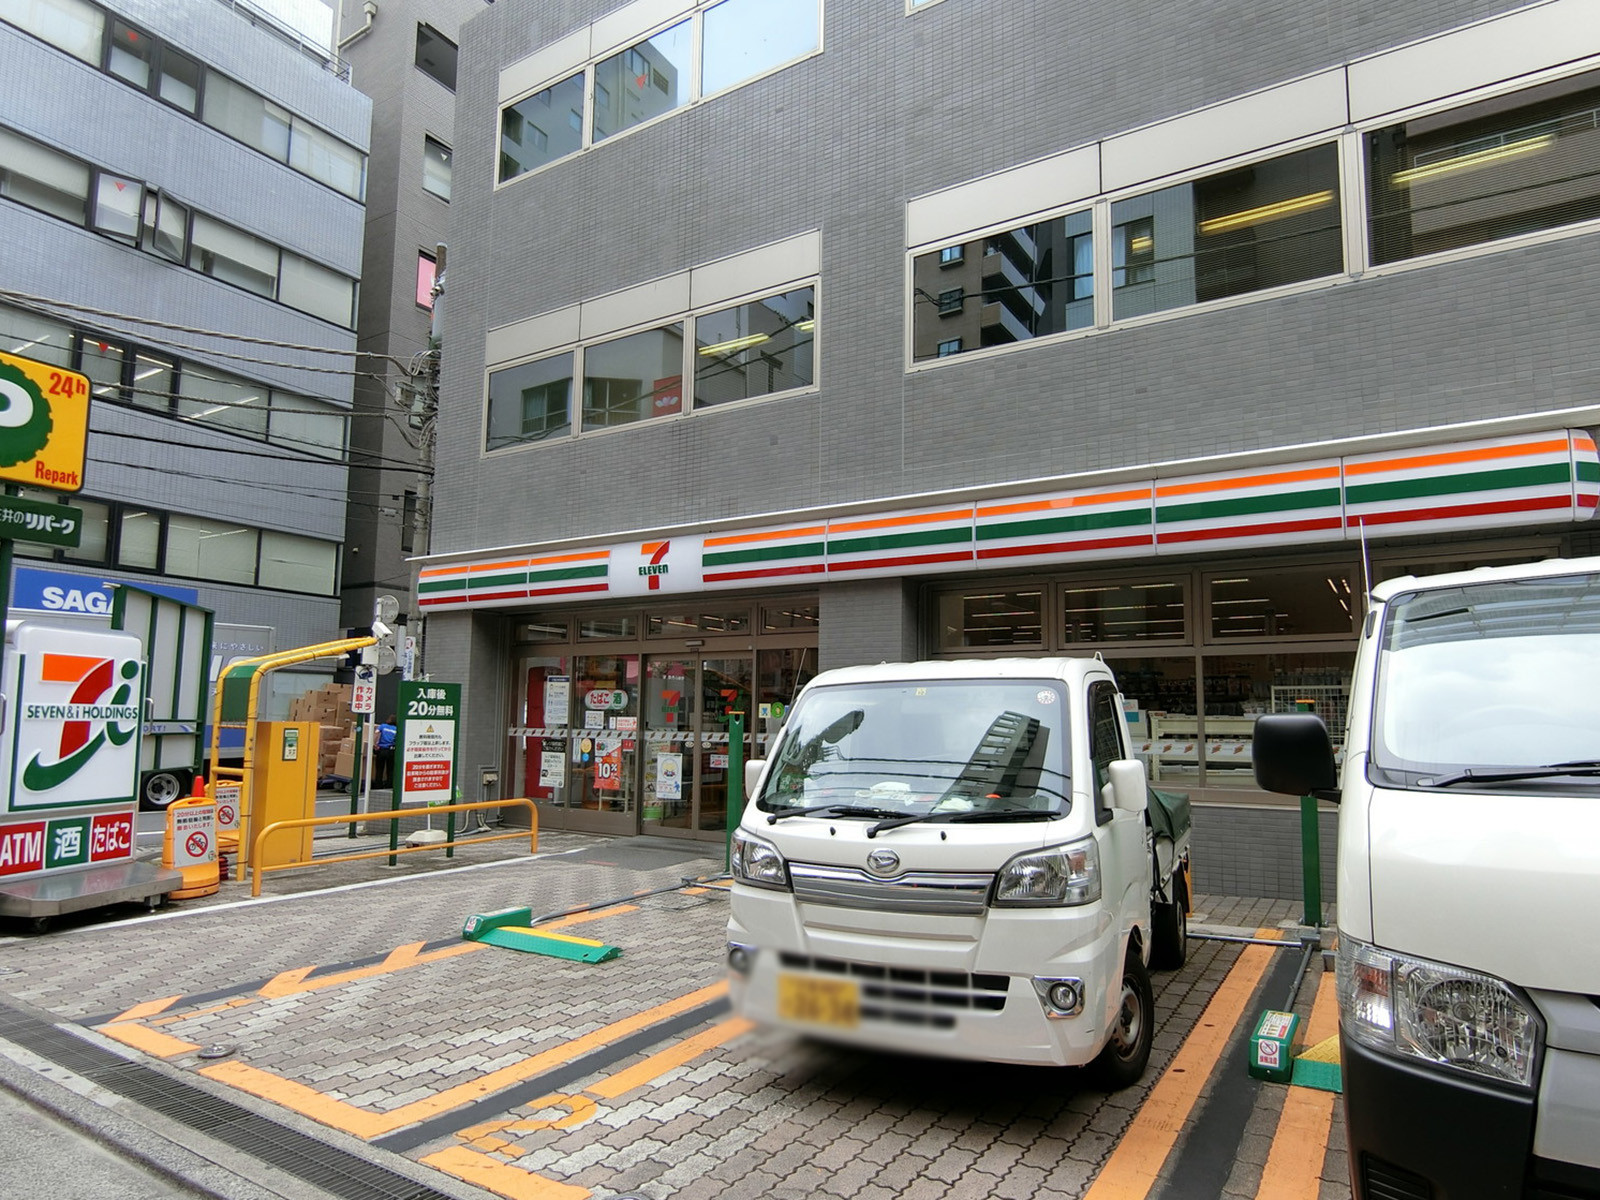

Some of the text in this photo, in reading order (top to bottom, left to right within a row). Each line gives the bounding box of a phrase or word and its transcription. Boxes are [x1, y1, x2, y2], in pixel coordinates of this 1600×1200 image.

[49, 372, 86, 398] 24h
[35, 461, 78, 486] Repark
[0, 508, 75, 534] 井のリパーク
[365, 687, 373, 710] カメラ
[417, 688, 446, 700] 入庫後
[590, 692, 610, 704] たばこ
[82, 706, 138, 719] HOLDINGS
[408, 701, 454, 716] 20分無料
[0, 831, 42, 867] ATM
[54, 826, 83, 860] 酒
[92, 821, 131, 854] たばこ
